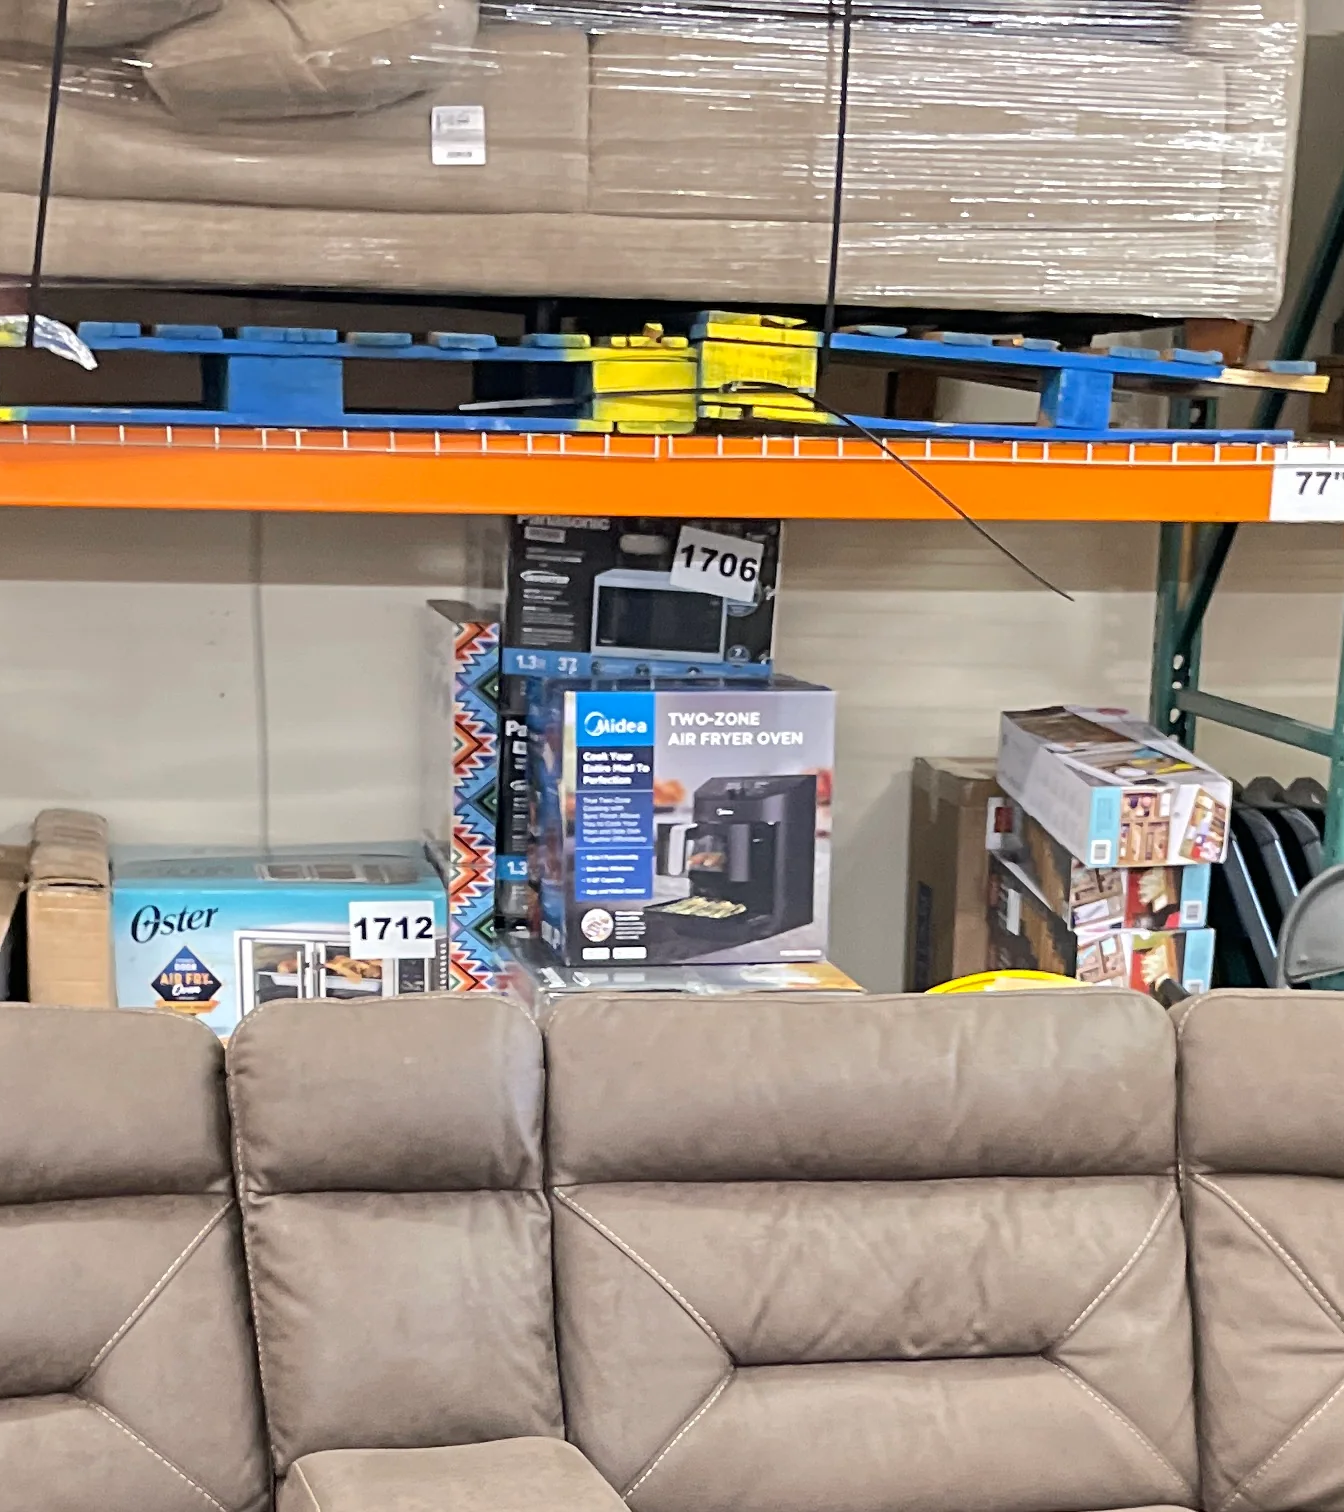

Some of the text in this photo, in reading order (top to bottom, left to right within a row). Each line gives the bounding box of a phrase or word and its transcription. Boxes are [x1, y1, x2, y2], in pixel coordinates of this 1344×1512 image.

[680, 544, 758, 583] 1706
[584, 711, 648, 737] Midea
[667, 712, 761, 726] TWO-ZONE
[667, 731, 803, 746] AIR FRYER OVEN
[582, 752, 634, 761] Cook Your
[637, 763, 651, 773] To
[582, 776, 632, 785] Perfection
[131, 903, 219, 944] Oster
[353, 916, 434, 941] 1712
[160, 972, 183, 986] AIR
